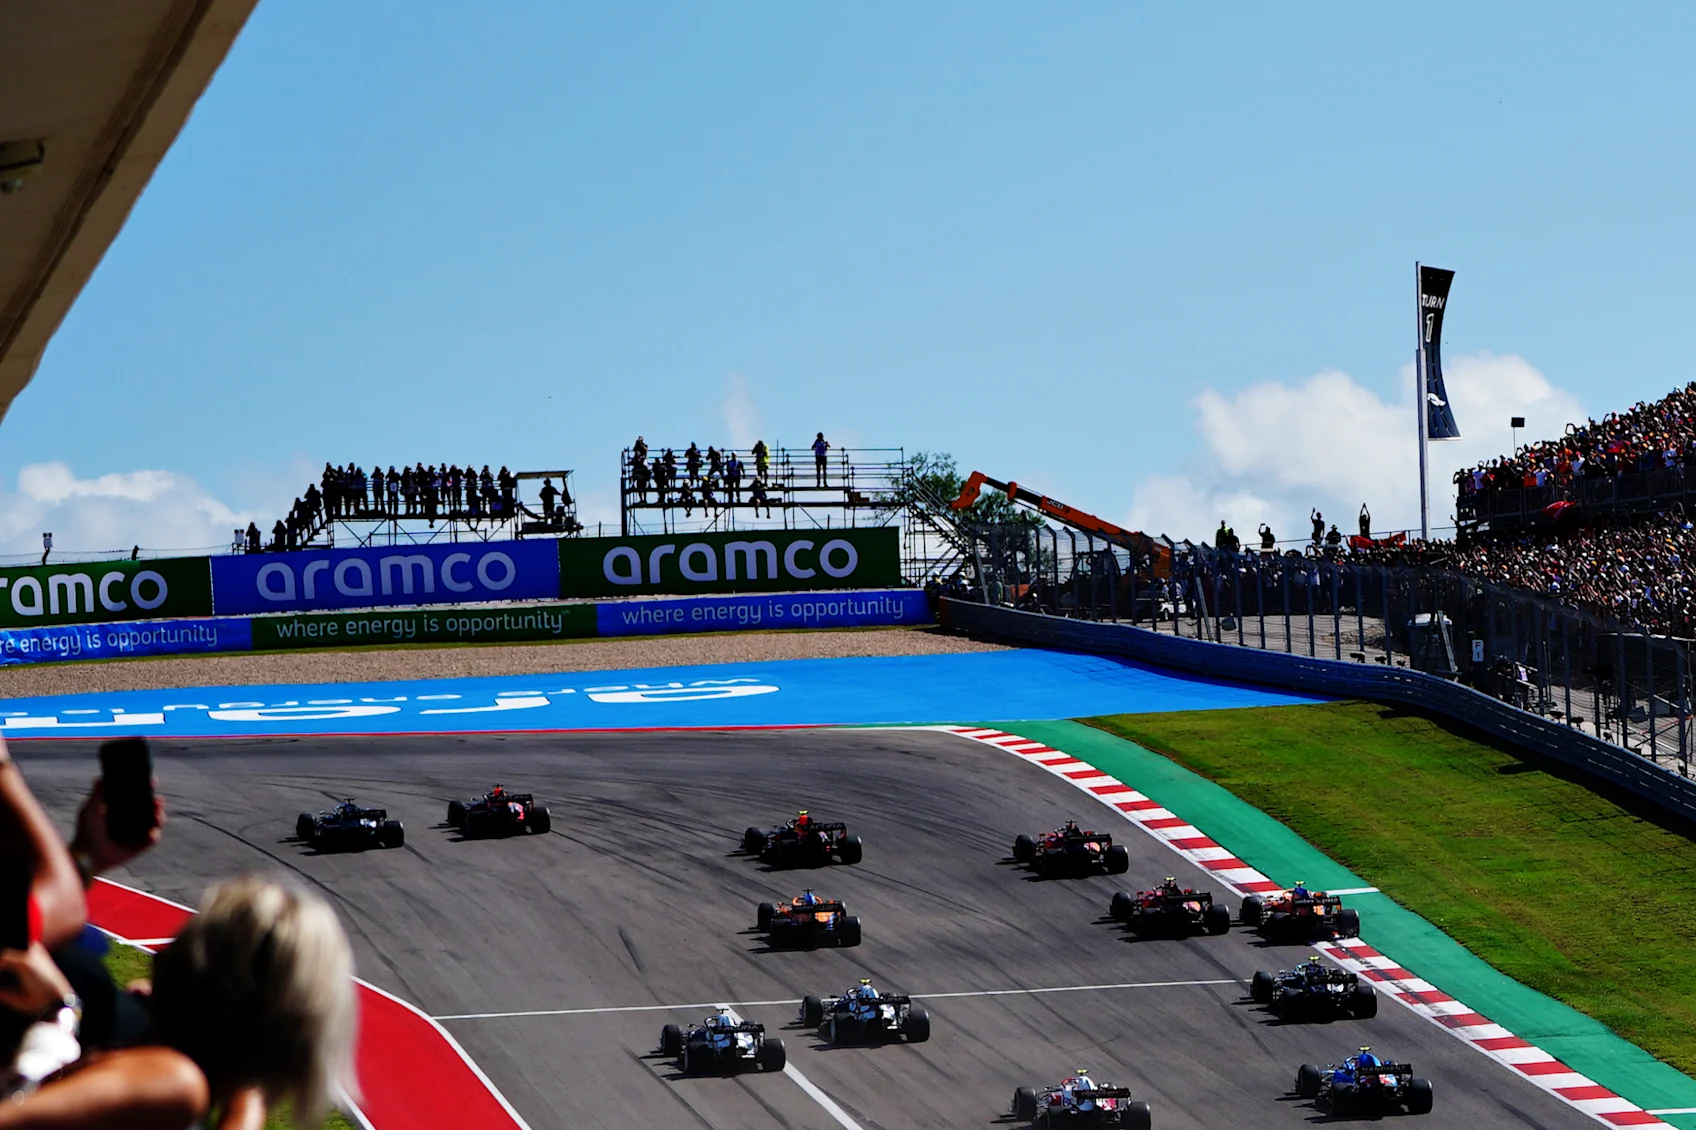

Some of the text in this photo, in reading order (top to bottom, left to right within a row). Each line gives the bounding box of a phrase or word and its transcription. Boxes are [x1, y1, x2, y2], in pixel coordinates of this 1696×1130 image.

[1422, 293, 1446, 309] TURN
[1426, 313, 1435, 343] 1
[1047, 499, 1064, 510] JCB
[256, 551, 516, 601] aramco
[602, 538, 859, 585] aramco
[277, 610, 562, 638] where energy is opportunity
[622, 597, 903, 625] where energy is opportunity
[20, 634, 81, 656] energy
[87, 630, 102, 648] is
[108, 624, 218, 652] opportunity
